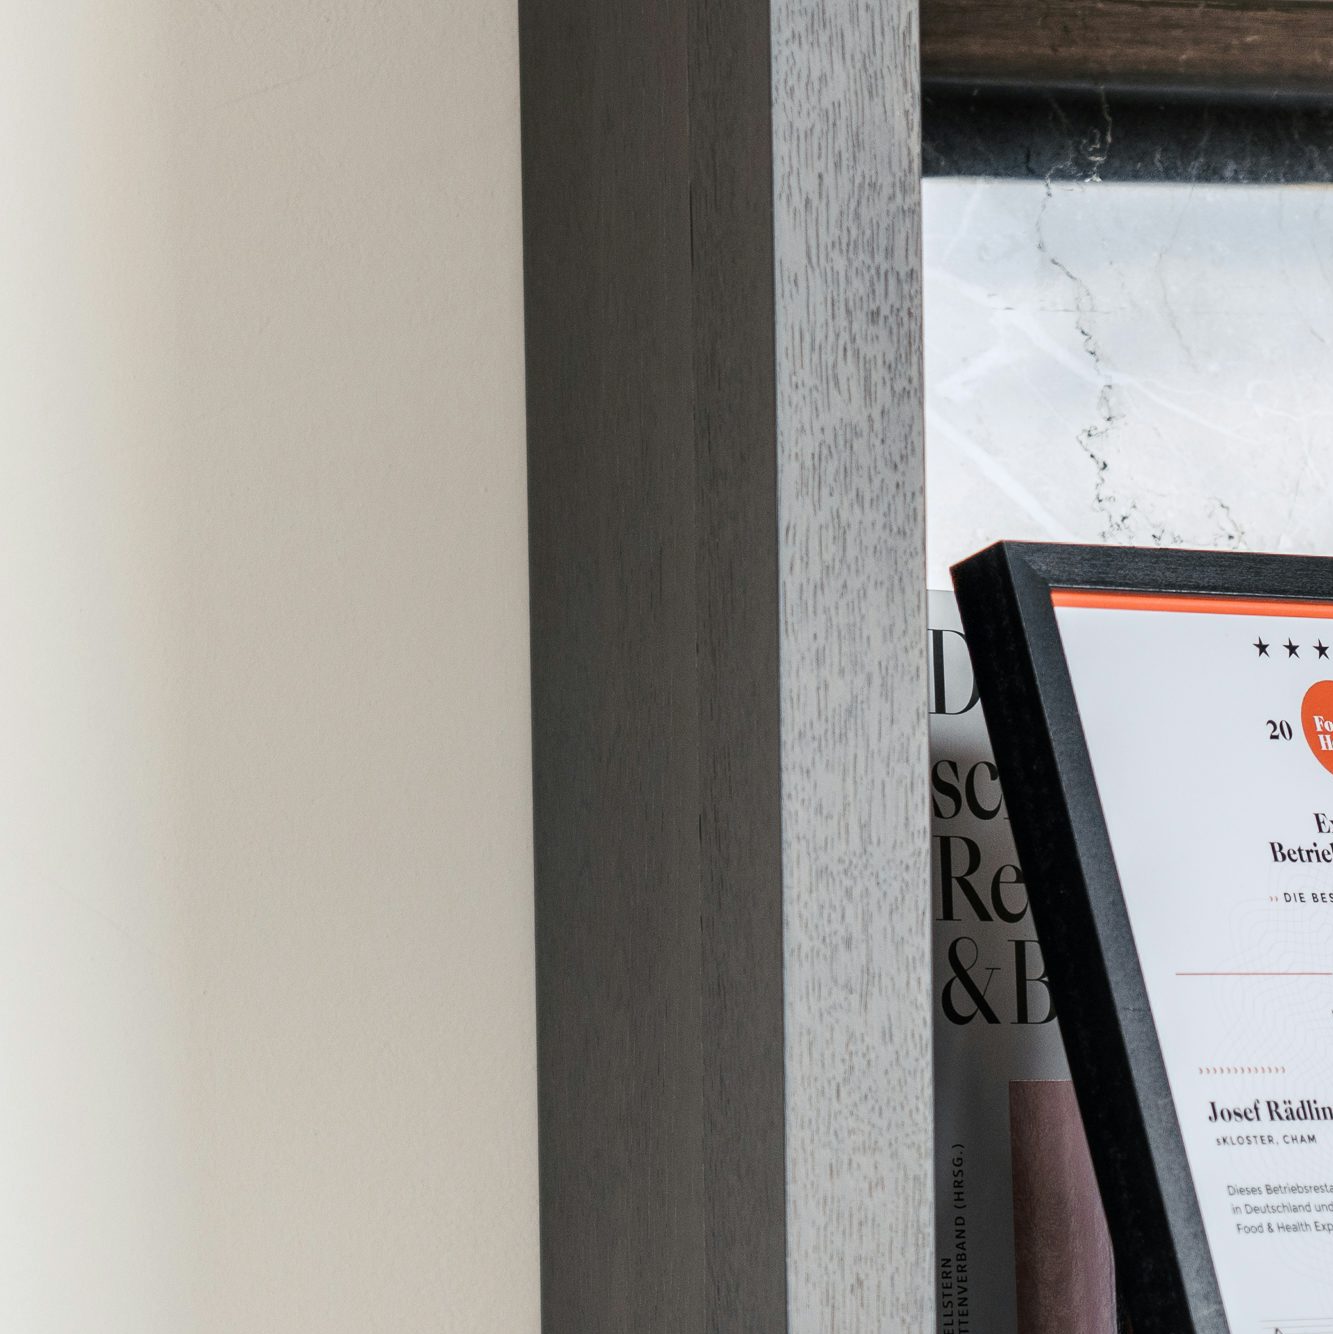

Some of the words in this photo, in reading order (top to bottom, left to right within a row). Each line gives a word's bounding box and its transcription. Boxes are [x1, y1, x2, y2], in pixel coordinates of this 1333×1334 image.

[1266, 720, 1292, 741] 20
[1284, 893, 1306, 903] DIE
[1208, 1099, 1261, 1122] Josef
[1282, 1134, 1317, 1144] CHAM
[951, 1143, 967, 1210] (HRSG.)
[1227, 1183, 1262, 1196] Dieses
[1232, 1204, 1242, 1214] in
[1245, 1201, 1311, 1214] Deutschland
[1315, 1201, 1333, 1213] und
[1236, 1222, 1264, 1234] Food
[1267, 1222, 1274, 1233] &
[1277, 1221, 1311, 1233] Health
